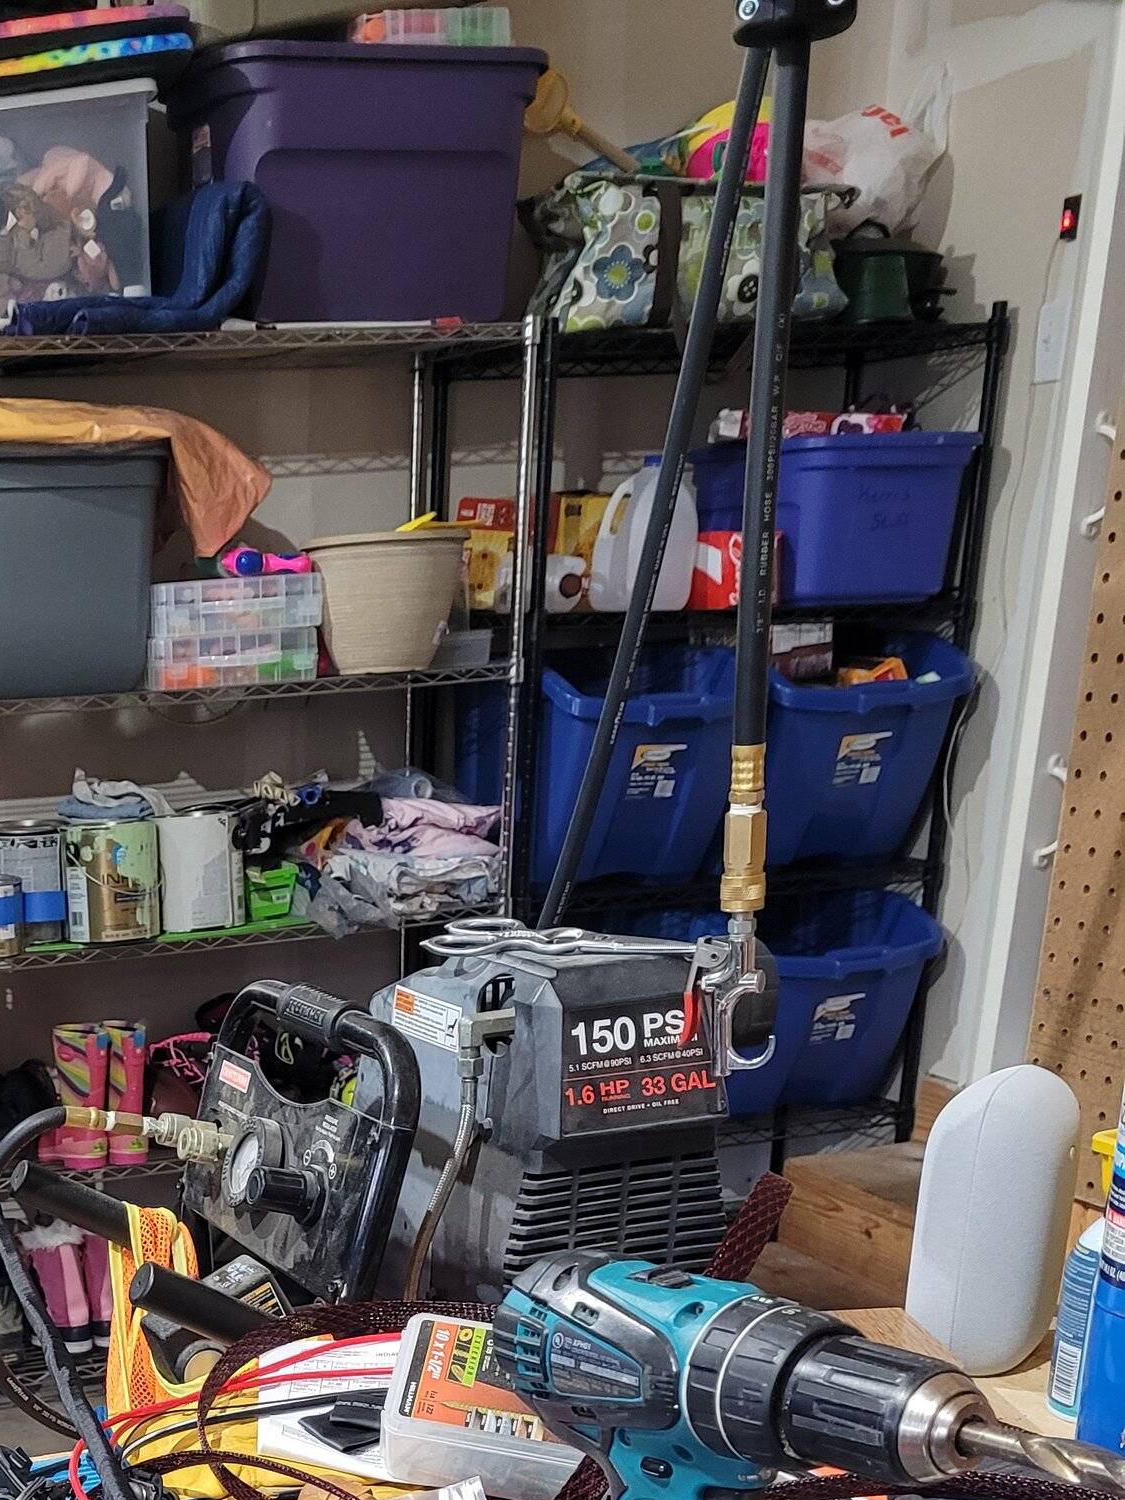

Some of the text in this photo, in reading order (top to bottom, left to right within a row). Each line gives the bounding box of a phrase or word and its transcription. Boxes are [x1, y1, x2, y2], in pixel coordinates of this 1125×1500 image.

[762, 491, 773, 522] HOSE
[758, 531, 771, 576] RUBBER
[571, 1009, 685, 1056] 150 PS
[644, 1032, 698, 1048] MAXIM
[569, 1062, 580, 1073] 5.1
[639, 1055, 652, 1064] 6.3
[564, 1070, 716, 1106] 1.6 HP 33 GAL
[603, 1105, 625, 1114] DIRECT
[627, 1103, 645, 1111] DRIVE
[663, 1098, 679, 1107] FREE
[404, 1381, 417, 1414] HILLMAN
